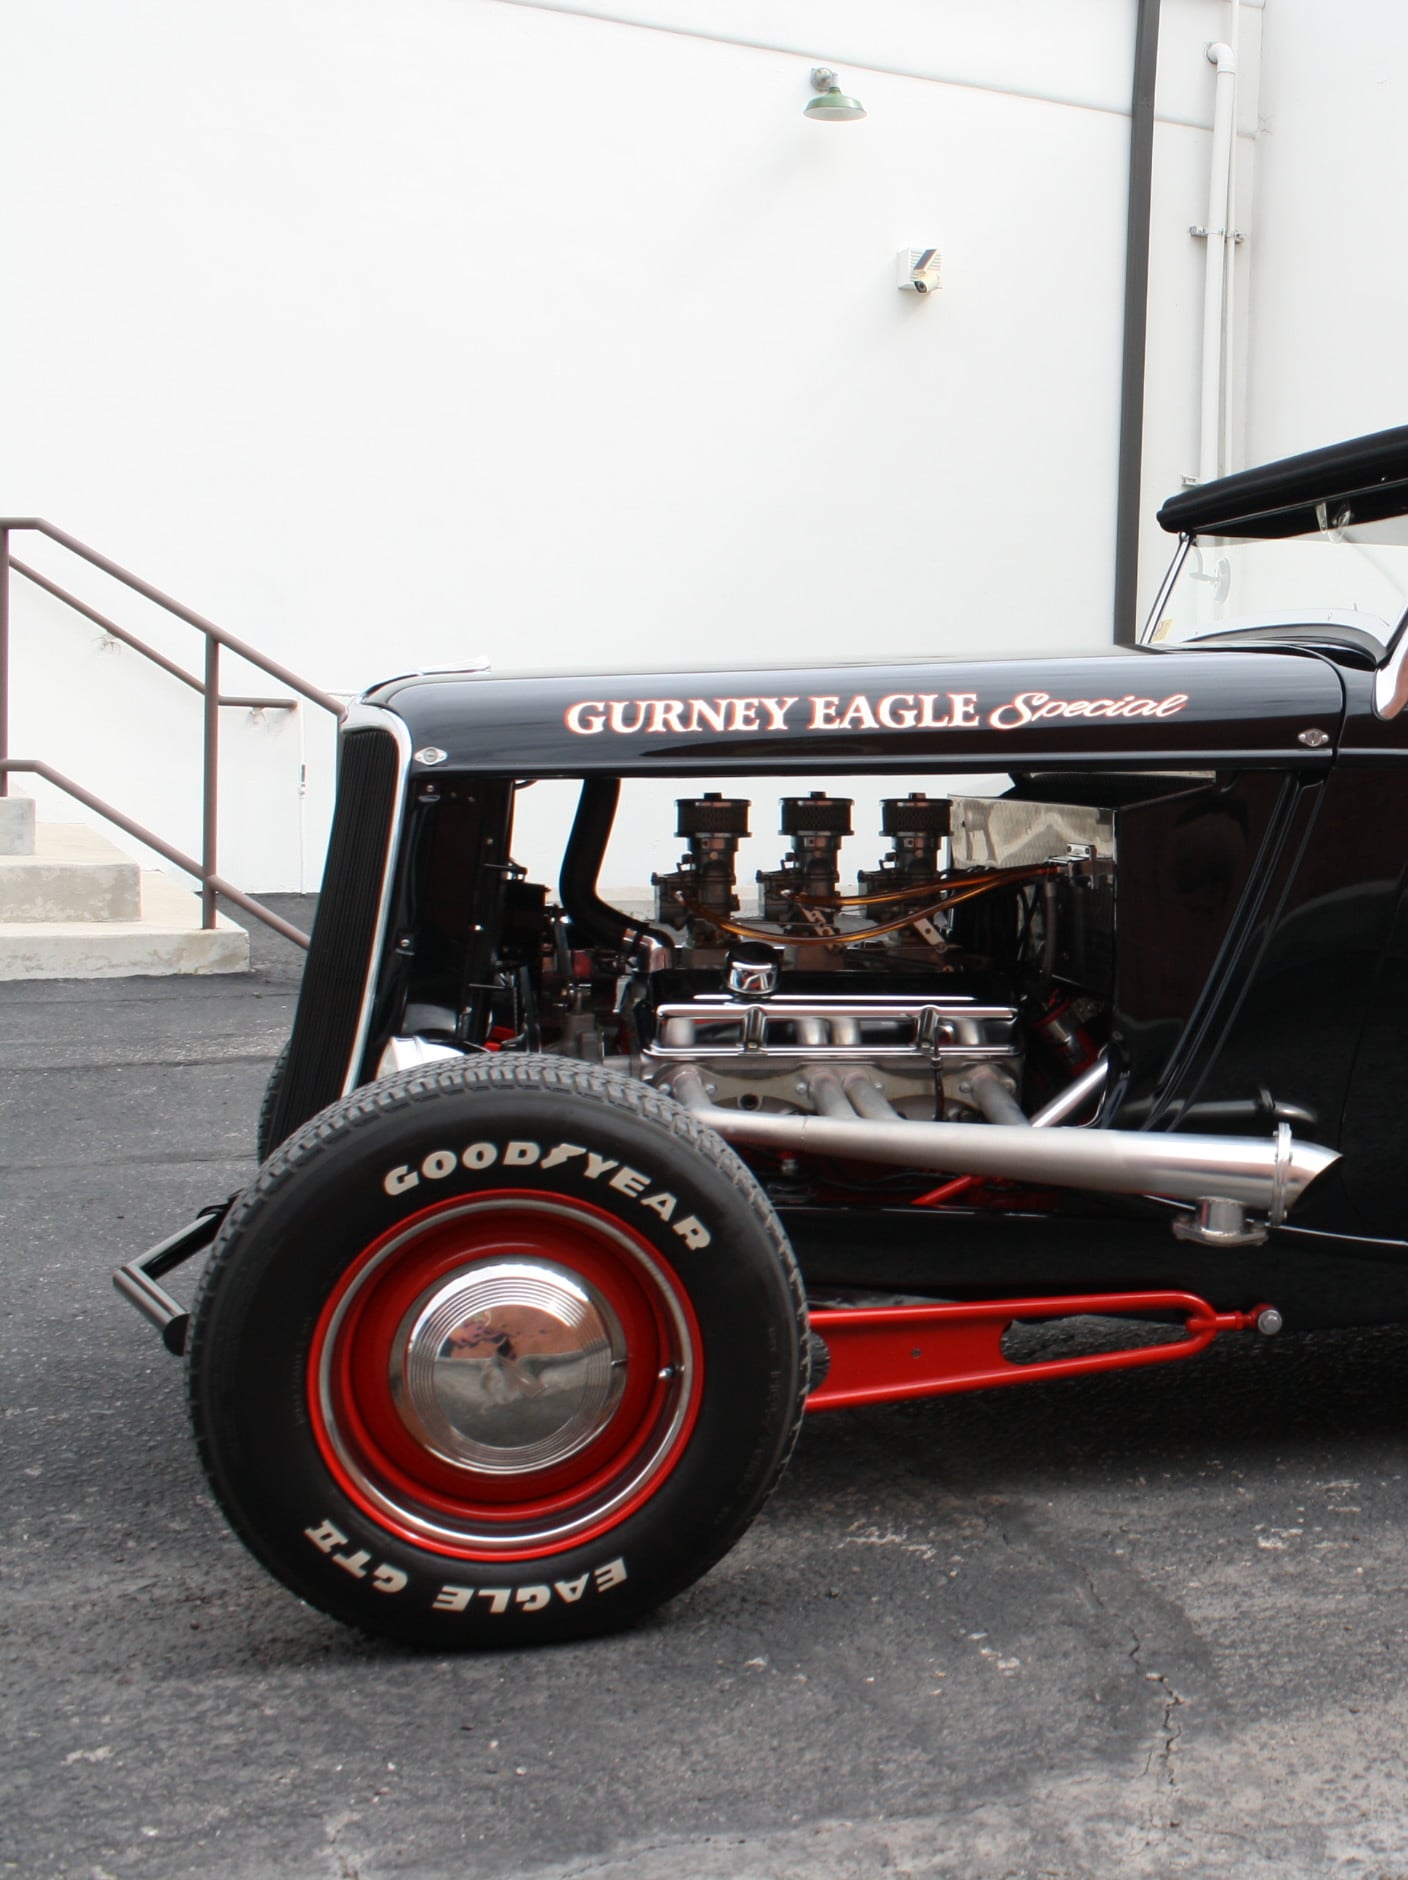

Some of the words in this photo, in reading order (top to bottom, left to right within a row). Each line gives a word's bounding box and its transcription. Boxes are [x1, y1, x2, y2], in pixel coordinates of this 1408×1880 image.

[564, 695, 799, 734] GURNEY
[806, 692, 979, 731] EAGLE
[988, 691, 1189, 731] Special
[383, 1140, 711, 1252] GOODYEAR
[432, 1555, 629, 1614] EAGLE
